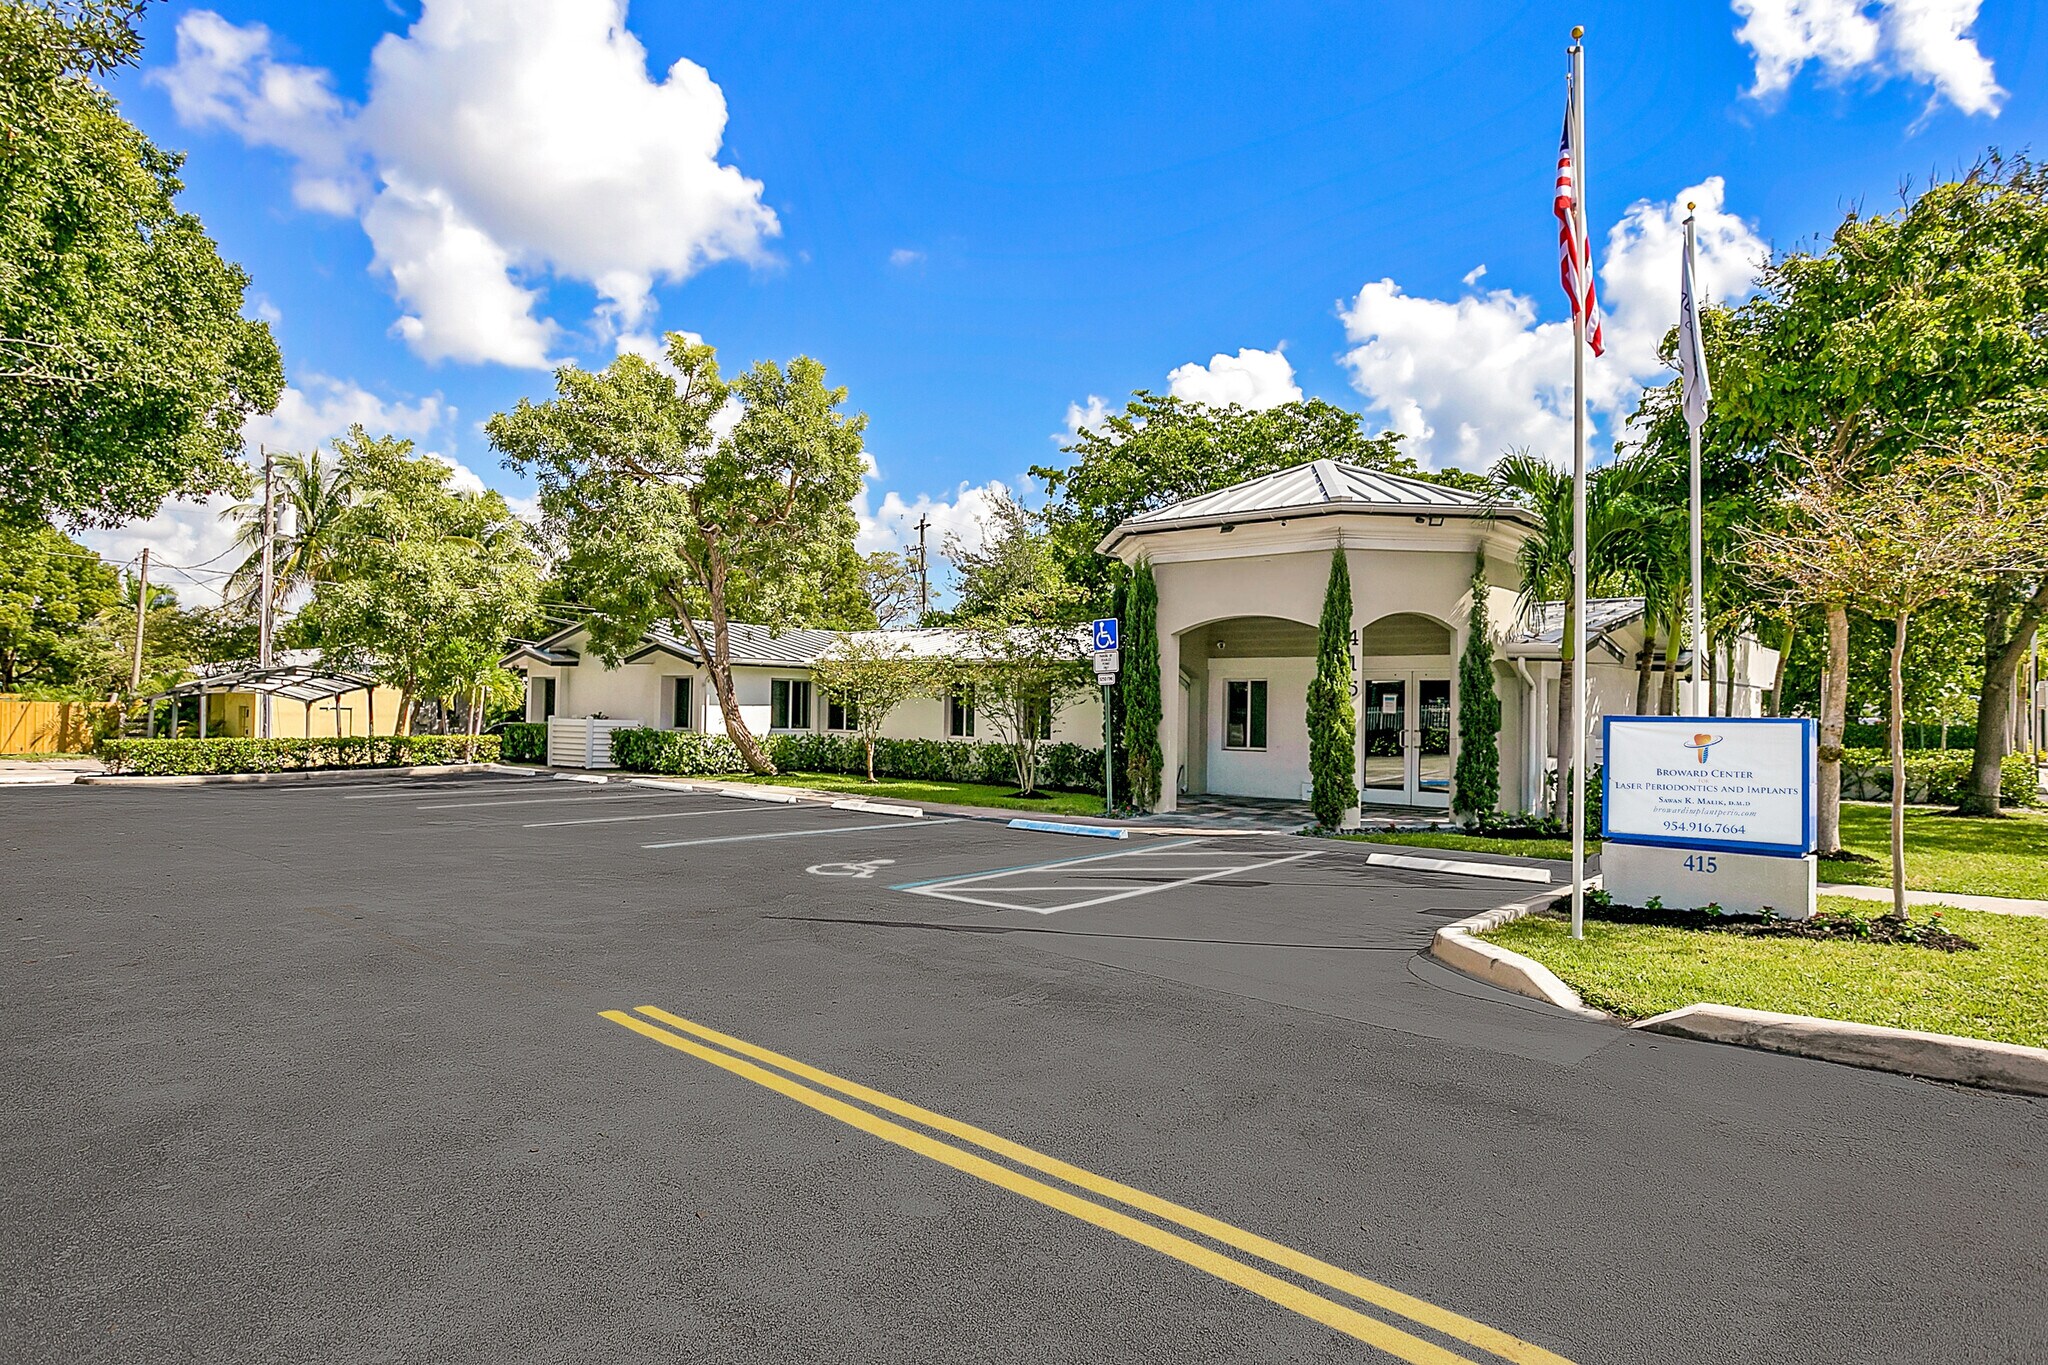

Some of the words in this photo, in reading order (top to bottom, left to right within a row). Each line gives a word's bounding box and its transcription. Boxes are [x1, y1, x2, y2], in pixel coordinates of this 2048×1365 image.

[1656, 768, 1708, 777] BROWARD
[1711, 769, 1753, 779] CENTER
[1615, 781, 1642, 790] LASER
[1645, 782, 1718, 793] PERIODONTICS
[1721, 785, 1744, 793] AND
[1747, 785, 1799, 795] IMPLANTS
[1658, 796, 1682, 804] SAWAN
[1653, 806, 1757, 818] browardimplantperio.com
[1663, 820, 1746, 834] 954.916.7664
[1683, 854, 1717, 873] 415
